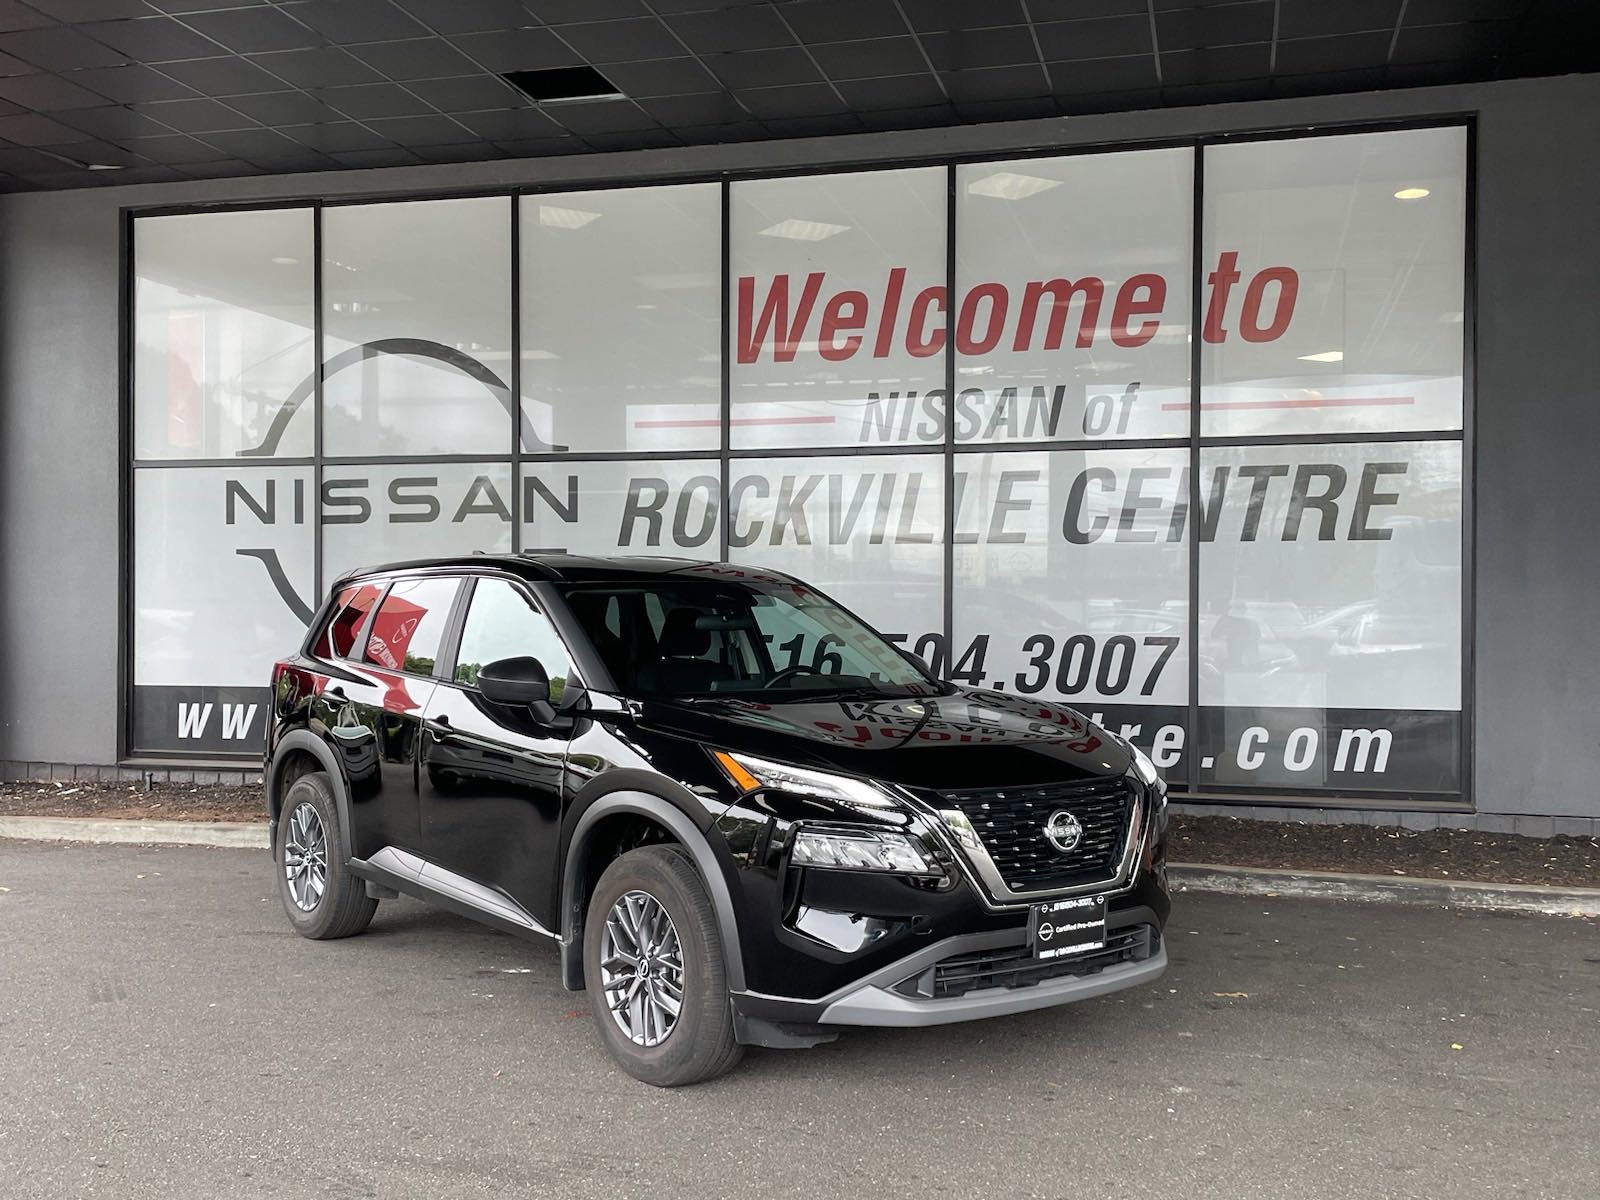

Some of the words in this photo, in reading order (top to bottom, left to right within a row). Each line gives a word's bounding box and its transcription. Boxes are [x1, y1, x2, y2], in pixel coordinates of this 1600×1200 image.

[737, 268, 1167, 365] Welcome
[1202, 251, 1299, 344] to
[859, 385, 1066, 443] NISSAN
[1082, 382, 1141, 436] of
[226, 476, 578, 524] NISSAN
[618, 470, 1041, 548] ROCKVILLE
[1062, 462, 1408, 545] CENTRE
